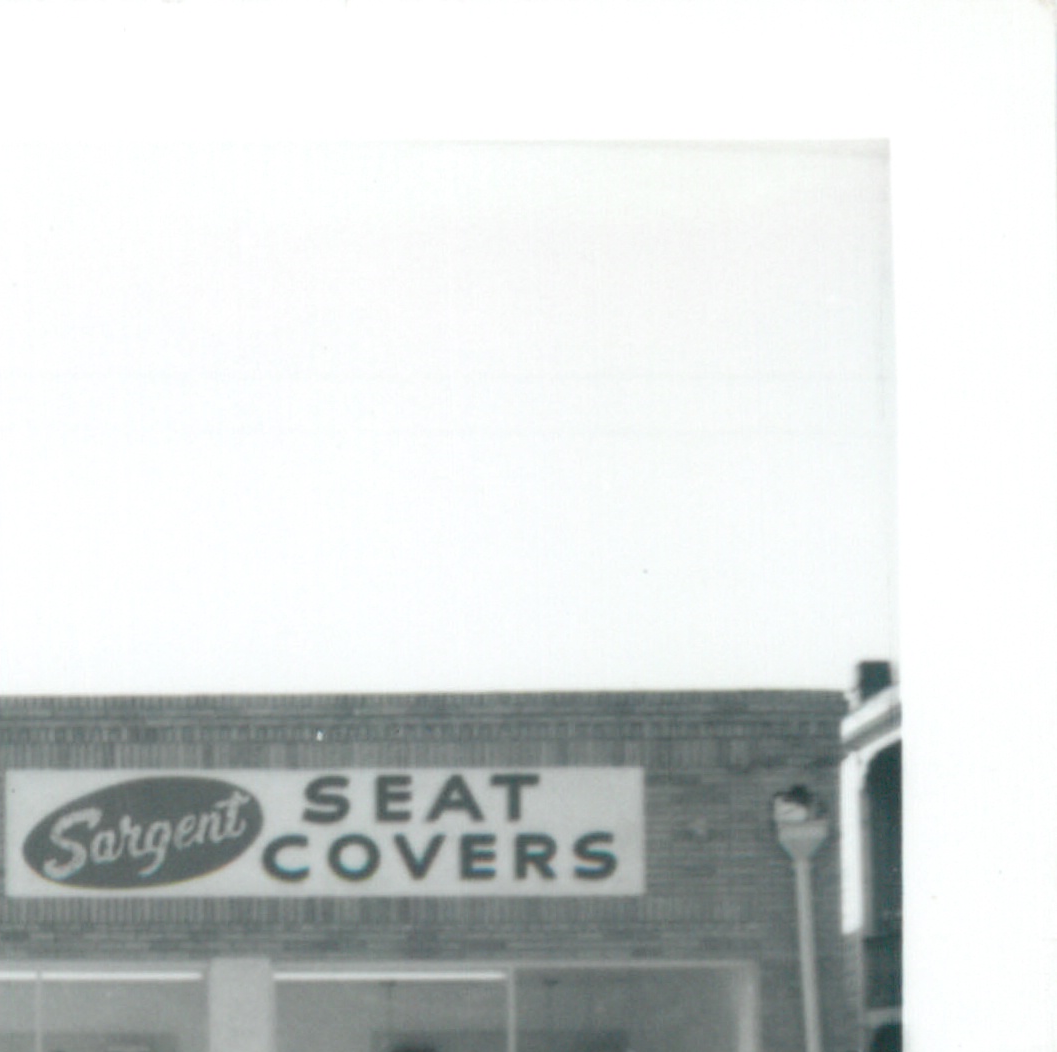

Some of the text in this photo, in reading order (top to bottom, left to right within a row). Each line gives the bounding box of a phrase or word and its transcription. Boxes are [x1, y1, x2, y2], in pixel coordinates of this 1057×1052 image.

[303, 773, 541, 824] SEAT
[43, 791, 250, 880] Sargent
[262, 832, 619, 883] COVERS
